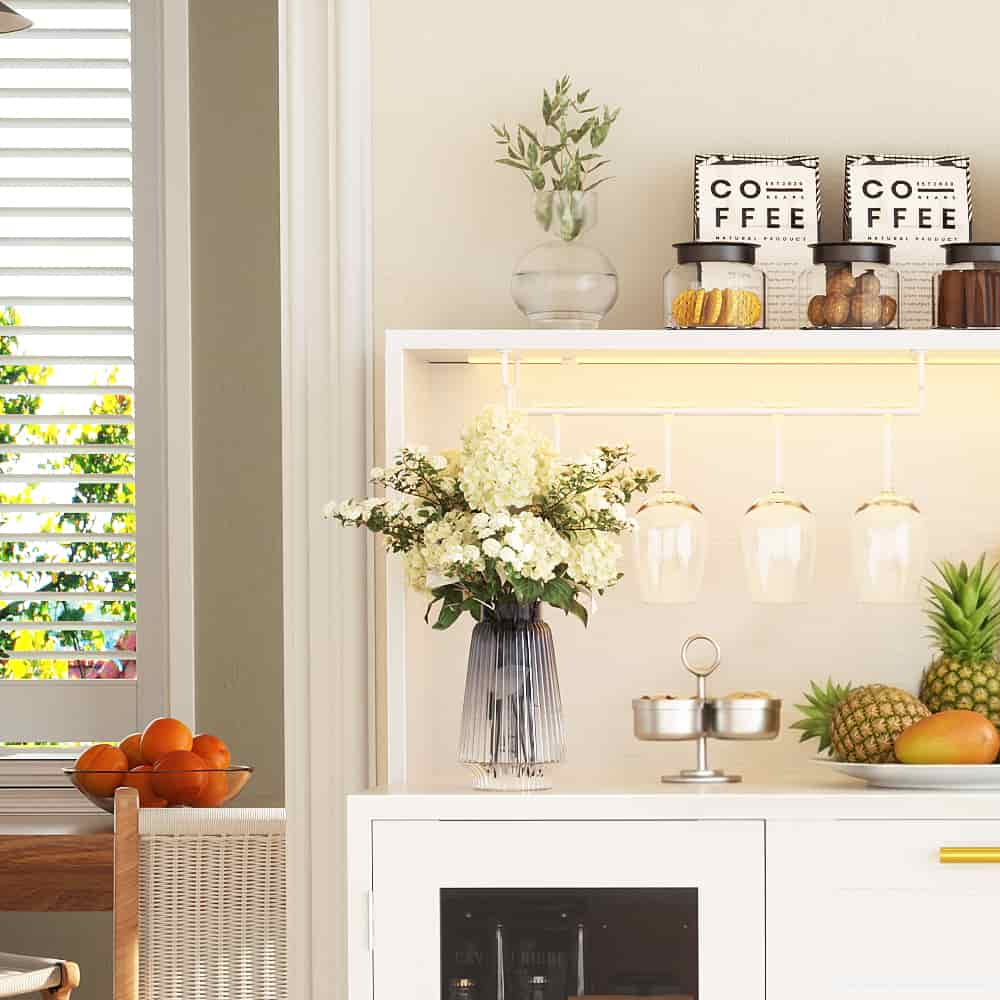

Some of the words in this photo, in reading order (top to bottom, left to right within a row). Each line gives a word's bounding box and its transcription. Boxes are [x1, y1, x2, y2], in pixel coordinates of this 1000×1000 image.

[710, 179, 761, 199] CO
[862, 179, 913, 199] CO
[715, 207, 805, 229] FFEE
[867, 207, 956, 230] FFEE
